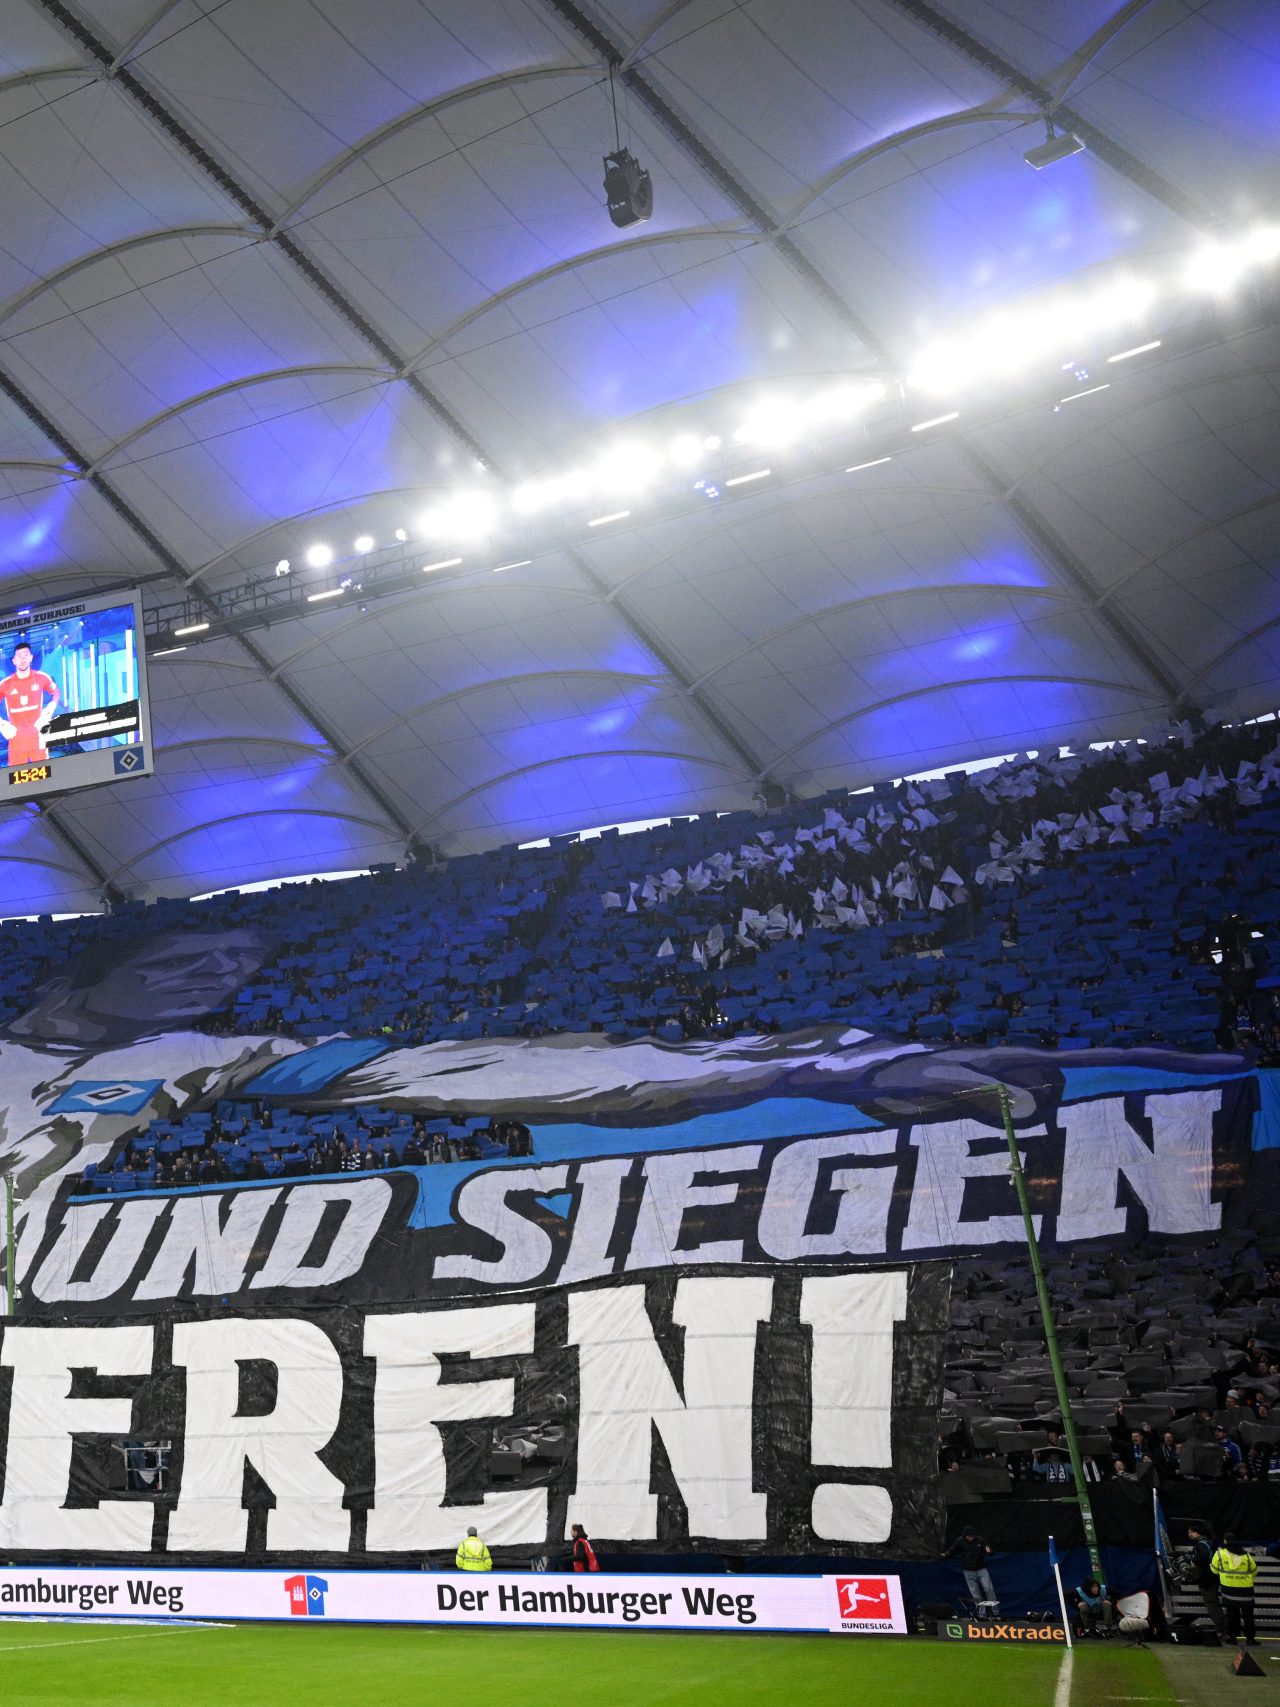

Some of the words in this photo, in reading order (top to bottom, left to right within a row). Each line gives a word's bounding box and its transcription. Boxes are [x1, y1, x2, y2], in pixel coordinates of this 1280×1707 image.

[33, 603, 86, 622] ZUHAUSE!
[13, 766, 48, 785] 15:24
[31, 1172, 402, 1304] UND
[433, 1088, 1224, 1286] SIEGEN
[127, 1580, 184, 1613] Weg
[437, 1584, 489, 1611] Der
[498, 1584, 673, 1623] Hamburger
[682, 1587, 757, 1625] Weg
[841, 1622, 894, 1630] BUNDESLIGA
[967, 1624, 1065, 1641] buXtrade
